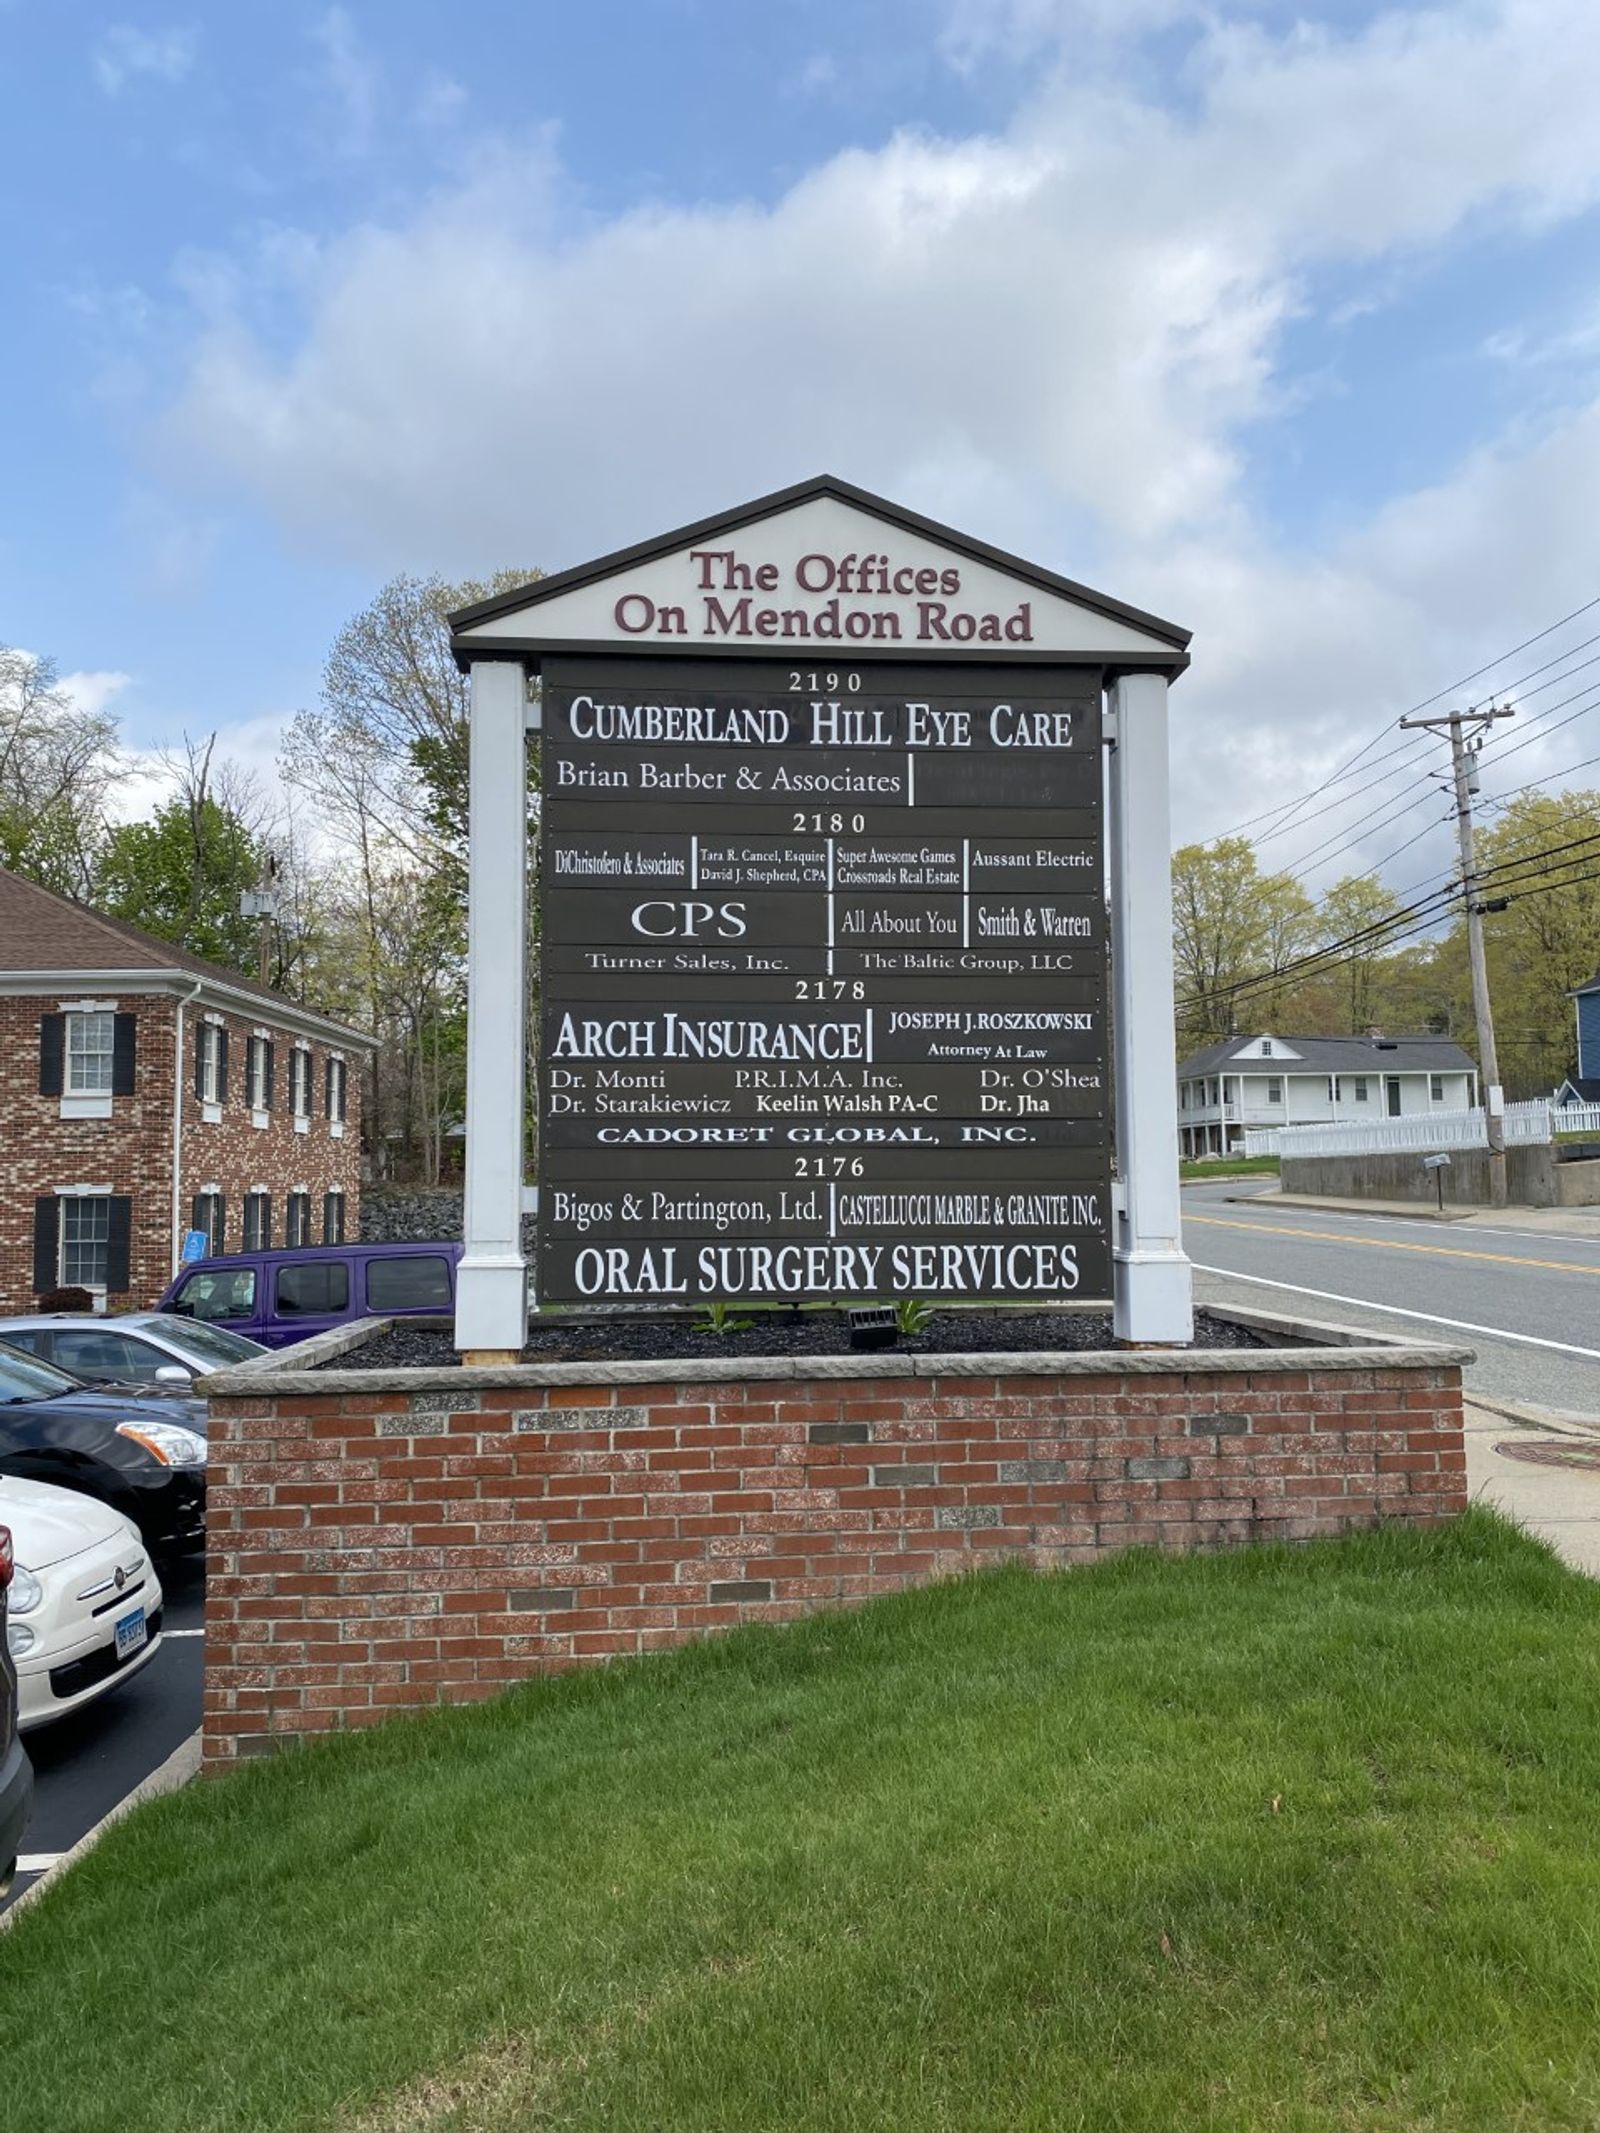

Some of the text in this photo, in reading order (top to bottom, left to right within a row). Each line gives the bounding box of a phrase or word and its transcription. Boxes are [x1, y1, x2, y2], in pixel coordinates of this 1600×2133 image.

[690, 550, 960, 594] The Offices
[615, 595, 1034, 642] On Mendon Road
[789, 672, 861, 692] 2190
[570, 696, 1073, 747] CUMBERLAND HILL EYE CARE
[557, 761, 629, 787] Brian
[639, 763, 726, 789] Barber
[736, 767, 762, 790] &
[770, 766, 901, 792] Associates
[793, 813, 865, 834] 2180
[623, 855, 632, 875] &
[635, 852, 684, 876] Associates
[700, 849, 723, 861] Tara
[727, 850, 738, 861] R.
[785, 850, 826, 869] Esquire
[836, 848, 956, 868] Super Awesome Games
[973, 850, 1093, 867] Aussant Electric
[701, 869, 826, 884] David J. Shepherd, CPA
[837, 869, 960, 884] Crossroads Real Estate
[631, 901, 746, 937] CPS
[841, 911, 957, 933] All About You
[978, 907, 1091, 937] Smith & Warren
[585, 953, 788, 971] Turner Sales, Inc.
[860, 953, 1073, 973] The Baltic Group, LLC
[795, 980, 865, 1000] 2178
[889, 1013, 960, 1033] JOSEPH
[552, 1012, 863, 1060] ARCH INSURANCE
[928, 1043, 1047, 1059] Attorney At Law
[550, 1070, 666, 1088] Dr. Monti
[862, 1070, 903, 1088] Inc.
[981, 1069, 1100, 1088] Dr. O'Shea
[550, 1094, 731, 1113] Dr. Starakiewicz
[757, 1095, 938, 1112] Keelin Walsh PA-C
[981, 1095, 1050, 1116] Dr. Jha
[597, 1127, 1036, 1144] CADORET GLOBAL, INC.
[795, 1157, 864, 1176] 2176
[554, 1191, 822, 1231] Bigos & Partington, Ltd.
[840, 1195, 1101, 1226] CASTELLUCCI MARBLE & GRANITE INC.
[575, 1245, 1079, 1294] ORAL SURGERY SERVICES
